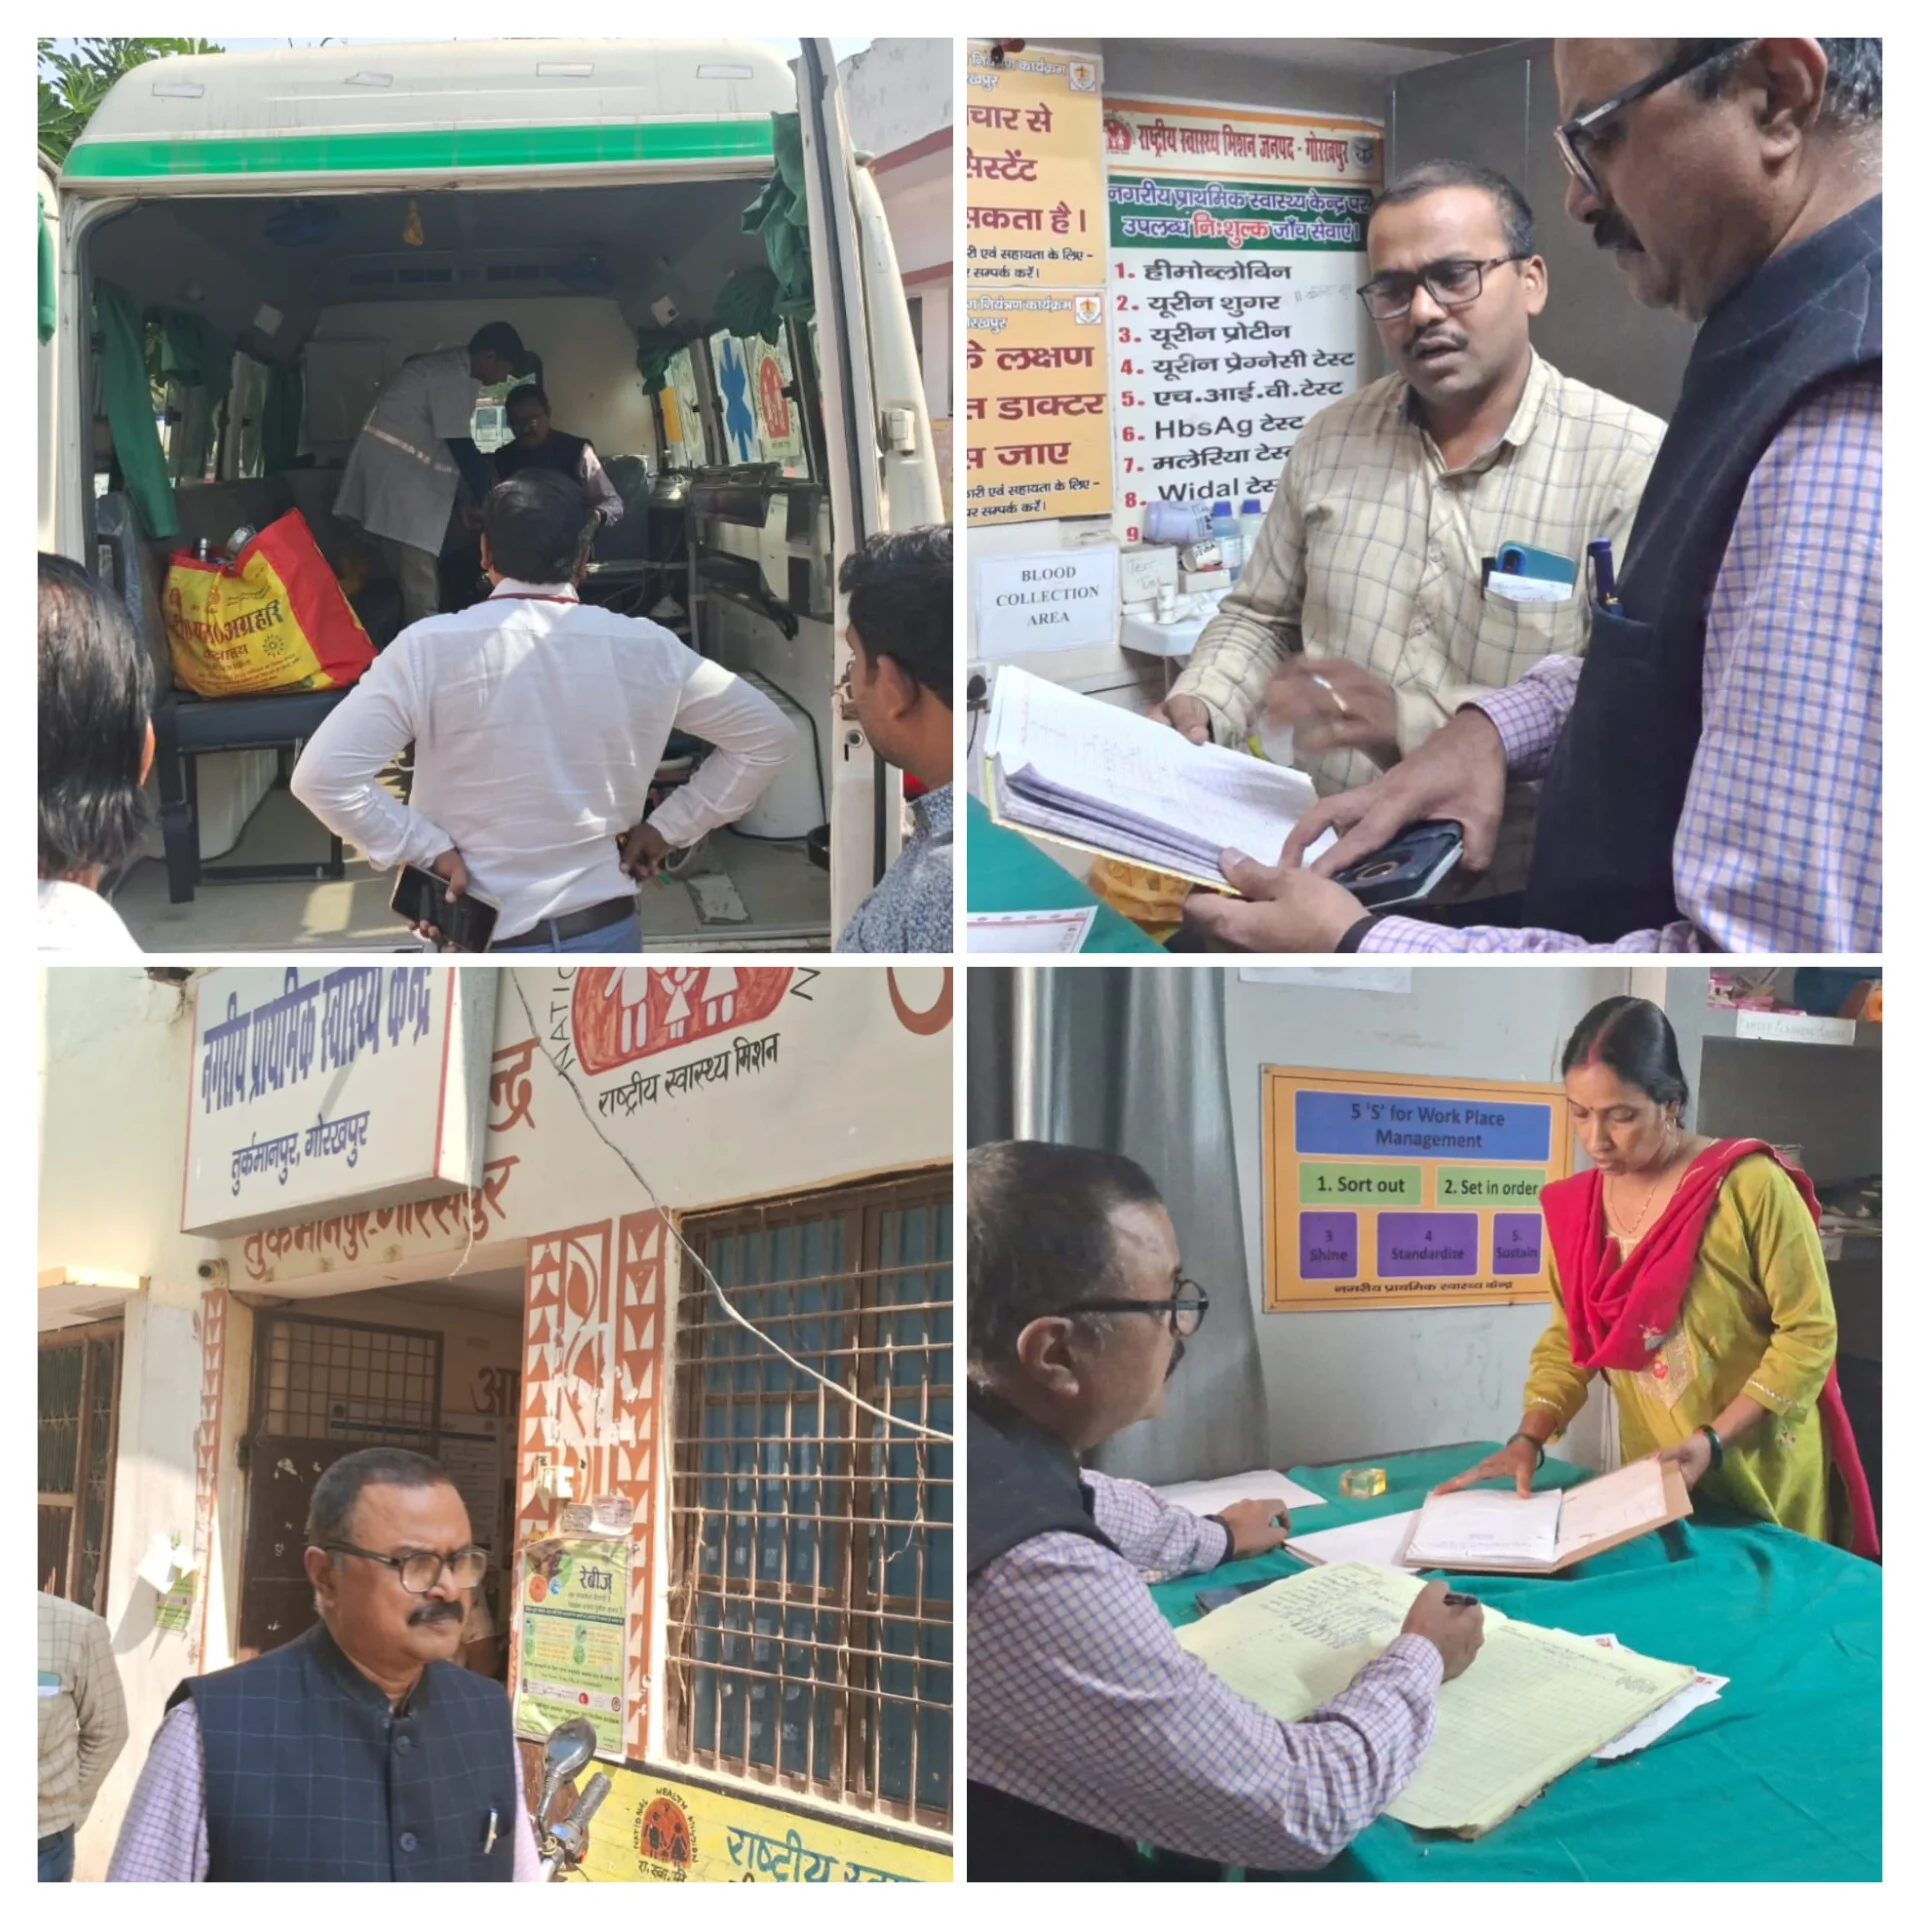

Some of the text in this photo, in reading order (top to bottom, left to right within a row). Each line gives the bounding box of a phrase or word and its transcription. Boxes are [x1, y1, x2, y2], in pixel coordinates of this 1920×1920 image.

[1025, 101, 1053, 133] से
[1137, 119, 1177, 158] राष्ट्रीय
[1178, 126, 1221, 156] स्वास्थ्य
[1221, 124, 1256, 159] मिशन
[1258, 132, 1295, 161] जनपद
[1304, 131, 1349, 173] गोरखपुर
[1108, 179, 1171, 206] नगरीय
[1171, 181, 1245, 210] प्राथमिक
[1248, 188, 1308, 211] स्वास्थ्य
[1308, 187, 1347, 214] केन्द्र
[1049, 200, 1072, 235] है
[1121, 215, 1190, 238] उपलब्ध
[980, 246, 997, 259] एवं
[1000, 249, 1044, 261] सहायता
[1047, 248, 1059, 261] के
[1062, 246, 1084, 262] लिए
[973, 265, 1010, 279] सम्पर्क
[1115, 259, 1292, 281] 1. हीमोब्लोबिन
[979, 295, 1022, 311] नियंत्रण
[1116, 290, 1282, 318] 2. यूरीन शुगर
[1118, 320, 1292, 350] 3. यूरीन प्रोटीन
[995, 346, 1095, 371] लक्षण
[1120, 359, 1145, 376] 4.
[1152, 353, 1219, 381] यूरीन
[1312, 349, 1356, 368] टेस्ट
[996, 393, 1107, 421] डाक्टर
[1121, 391, 1146, 408] 5.
[1122, 426, 1146, 443] 6.
[1155, 415, 1253, 440] HbsAg
[994, 442, 1072, 466] जाए
[1123, 458, 1145, 474] 7.
[1152, 446, 1251, 470] मलेरिया
[988, 482, 1005, 497] एवं
[1008, 481, 1051, 496] सहायता
[1054, 478, 1066, 491] के
[1069, 476, 1091, 491] लिए
[1124, 492, 1148, 508] 8.
[1157, 477, 1239, 501] Widal
[981, 500, 1018, 518] सम्पर्क
[1021, 566, 1077, 582] BLOOD
[995, 585, 1101, 607] COLLECTION
[1027, 611, 1070, 627] AREA
[202, 991, 252, 1114] नगरीय
[249, 967, 321, 1104] प्राथमिक
[321, 967, 383, 1073] स्वास्थ्य
[598, 1032, 781, 1117] राष्ट्रीय स्वास्थ्य मिशन
[1351, 1103, 1361, 1120] 5
[1389, 1104, 1414, 1122] for
[1418, 1107, 1461, 1124] Work
[1464, 1108, 1506, 1126] Place
[305, 1110, 371, 1168] गोरखपुर
[1375, 1128, 1483, 1150] Management
[1317, 1176, 1406, 1193] 1. Sort out
[1444, 1179, 1539, 1196] 2. Set in order
[1424, 1229, 1433, 1243] 4
[1309, 1247, 1348, 1262] Shine
[1390, 1247, 1465, 1261] Standardize
[1495, 1246, 1538, 1259] Sustain
[579, 1565, 613, 1595] रेबीज
[727, 1828, 840, 1882] राष्ट्रीय
